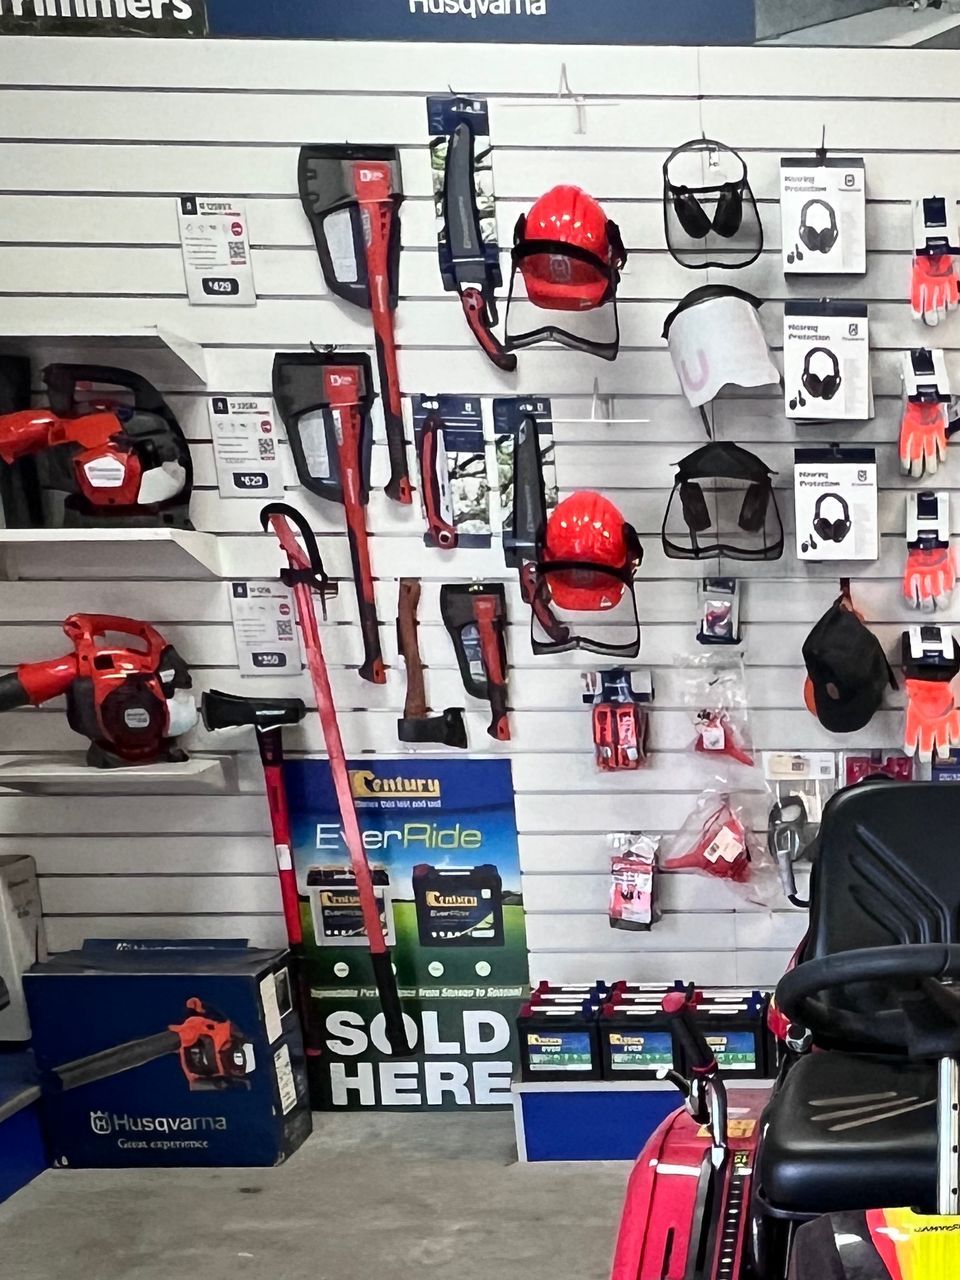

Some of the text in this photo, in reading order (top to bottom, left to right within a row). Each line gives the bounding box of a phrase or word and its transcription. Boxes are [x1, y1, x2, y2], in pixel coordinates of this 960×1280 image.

[0, 0, 193, 19] rimmers
[409, 0, 547, 18] Husqvarna
[325, 1010, 511, 1056] SOLD
[329, 1060, 513, 1105] HERE
[113, 1113, 227, 1134] Husqvarna
[117, 1138, 208, 1150] Great experience
